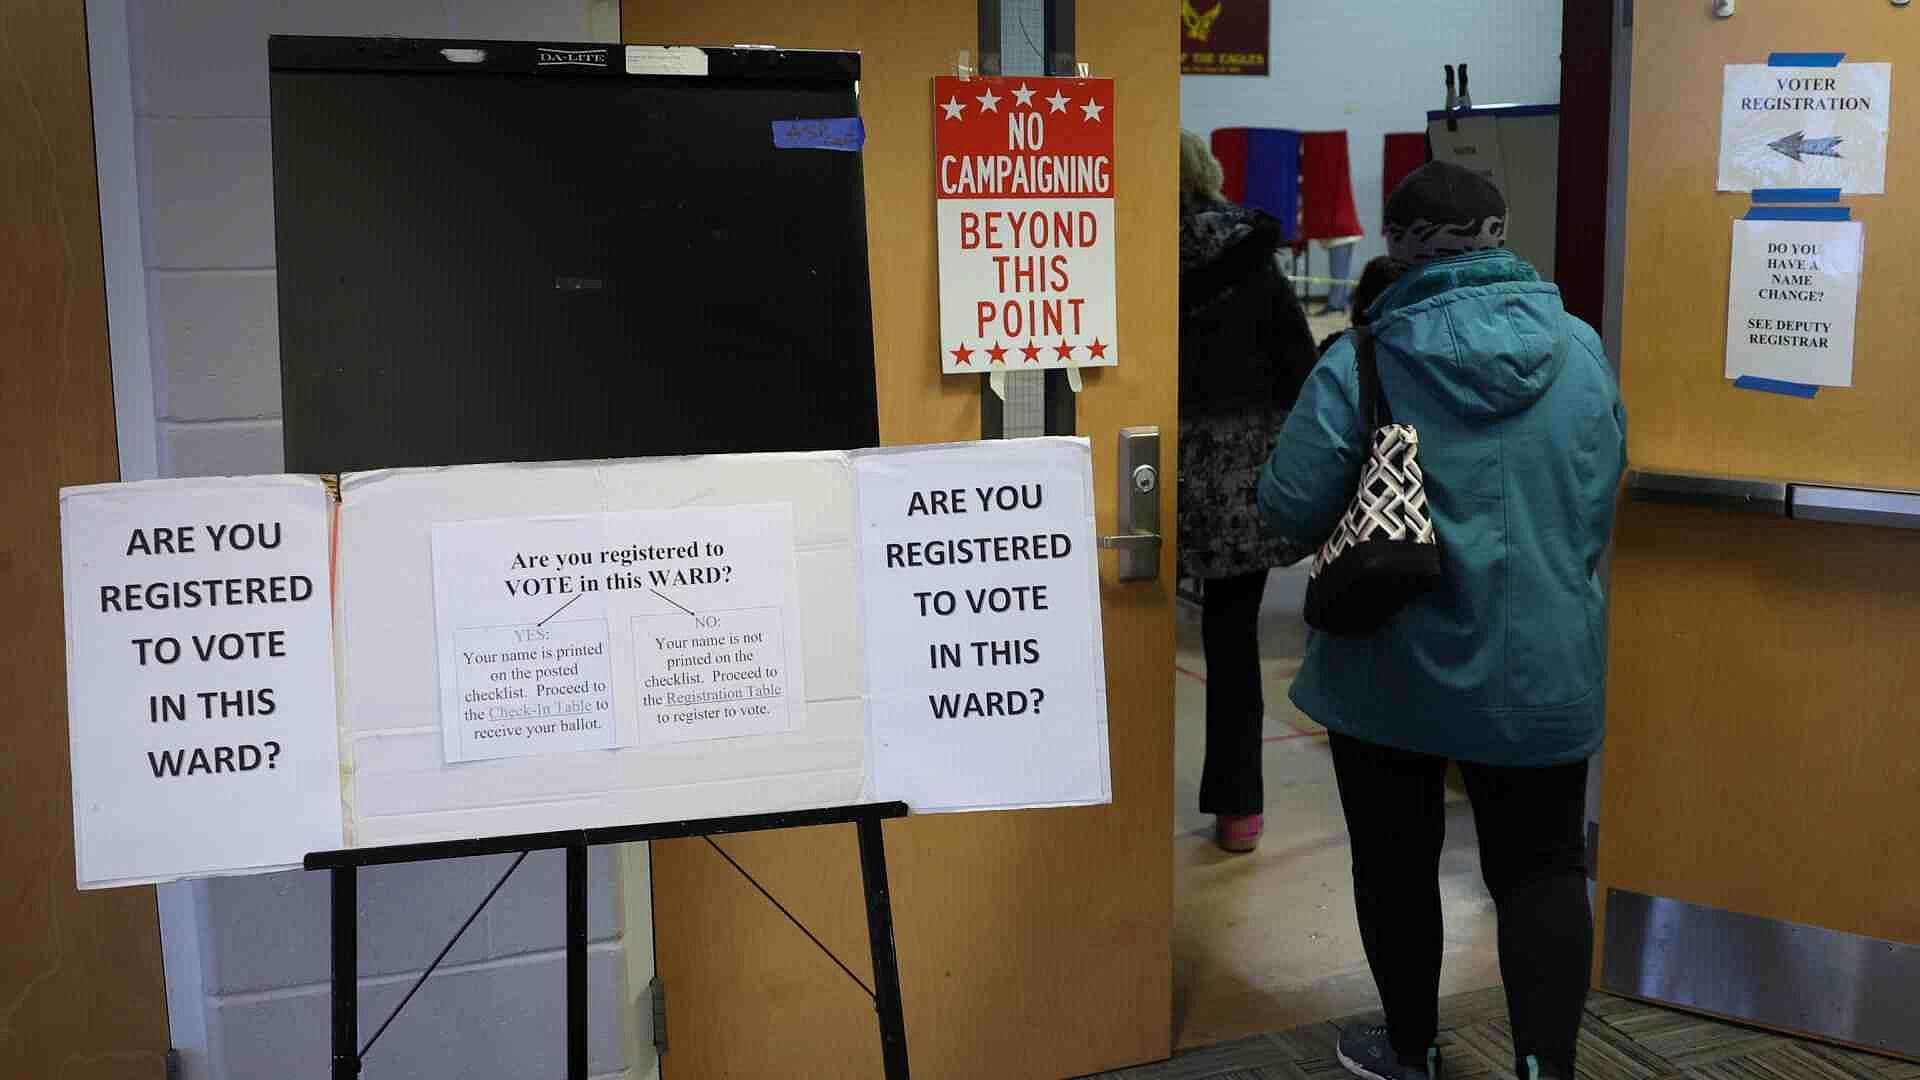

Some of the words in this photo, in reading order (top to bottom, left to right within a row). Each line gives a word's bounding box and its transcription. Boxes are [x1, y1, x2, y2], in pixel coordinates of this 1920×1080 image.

[540, 53, 605, 63] DA-LITE
[1776, 77, 1837, 92] VOTER
[1740, 97, 1871, 112] REGISTRATION
[1007, 111, 1045, 151] NO
[942, 155, 1109, 194] CAMPAIGNING
[960, 210, 1098, 250] BEYOND
[1767, 243, 1788, 254] DO
[992, 254, 1069, 293] THIS
[1767, 258, 1806, 270] HAVE
[1808, 260, 1819, 271] A
[1771, 274, 1813, 286] NAME
[1758, 289, 1825, 302] CHANGE?
[976, 297, 1085, 338] POINT
[1747, 318, 1773, 330] SEE
[1776, 320, 1831, 333] DEPUTY
[1749, 333, 1829, 348] REGISTRAR
[907, 488, 967, 516] ARE
[976, 484, 1043, 512] YOU
[126, 526, 196, 556] ARE
[206, 522, 282, 551] YOU
[886, 533, 1072, 568] REGISTERED
[511, 552, 549, 570] Are
[555, 549, 593, 571] you
[600, 541, 699, 567] registered
[705, 540, 725, 558] to
[505, 576, 574, 598] VOTE
[580, 574, 599, 593] in
[606, 571, 643, 590] this
[648, 566, 733, 587] WARD?
[100, 575, 313, 613] REGISTERED
[914, 590, 956, 617] TO
[965, 585, 1049, 614] VOTE
[695, 615, 721, 629] NO:
[514, 628, 551, 643] YES:
[655, 636, 688, 650] Your
[691, 635, 726, 648] name
[729, 632, 740, 645] is
[743, 631, 763, 644] not
[131, 637, 181, 666] TO
[192, 630, 286, 662] VOTE
[463, 652, 498, 665] Your
[502, 650, 538, 662] name
[542, 646, 553, 659] is
[556, 642, 603, 660] printed
[666, 651, 711, 671] printed
[715, 654, 731, 665] on
[735, 648, 753, 662] the
[929, 643, 961, 669] IN
[970, 638, 1040, 666] THIS
[490, 670, 508, 681] on
[511, 667, 532, 680] the
[535, 663, 579, 681] posted
[644, 671, 705, 688] checklist.
[712, 666, 762, 682] Proceed
[766, 667, 778, 679] to
[464, 686, 528, 703] checklist.
[536, 681, 589, 697] Proceed
[593, 681, 607, 693] to
[643, 693, 663, 707] the
[666, 687, 744, 706] Registration
[745, 683, 782, 698] Table
[928, 688, 1045, 719] WARD?
[149, 694, 186, 723] IN
[197, 688, 276, 719] THIS
[464, 708, 485, 721] the
[488, 703, 551, 720] Check-In
[553, 700, 593, 716] Table
[595, 700, 609, 711] to
[656, 712, 670, 724] to
[673, 707, 721, 725] register
[724, 706, 737, 718] to
[740, 705, 770, 717] vote.
[474, 725, 523, 740] receive
[525, 723, 557, 739] your
[560, 717, 602, 732] ballot.
[147, 741, 282, 778] WARD?
